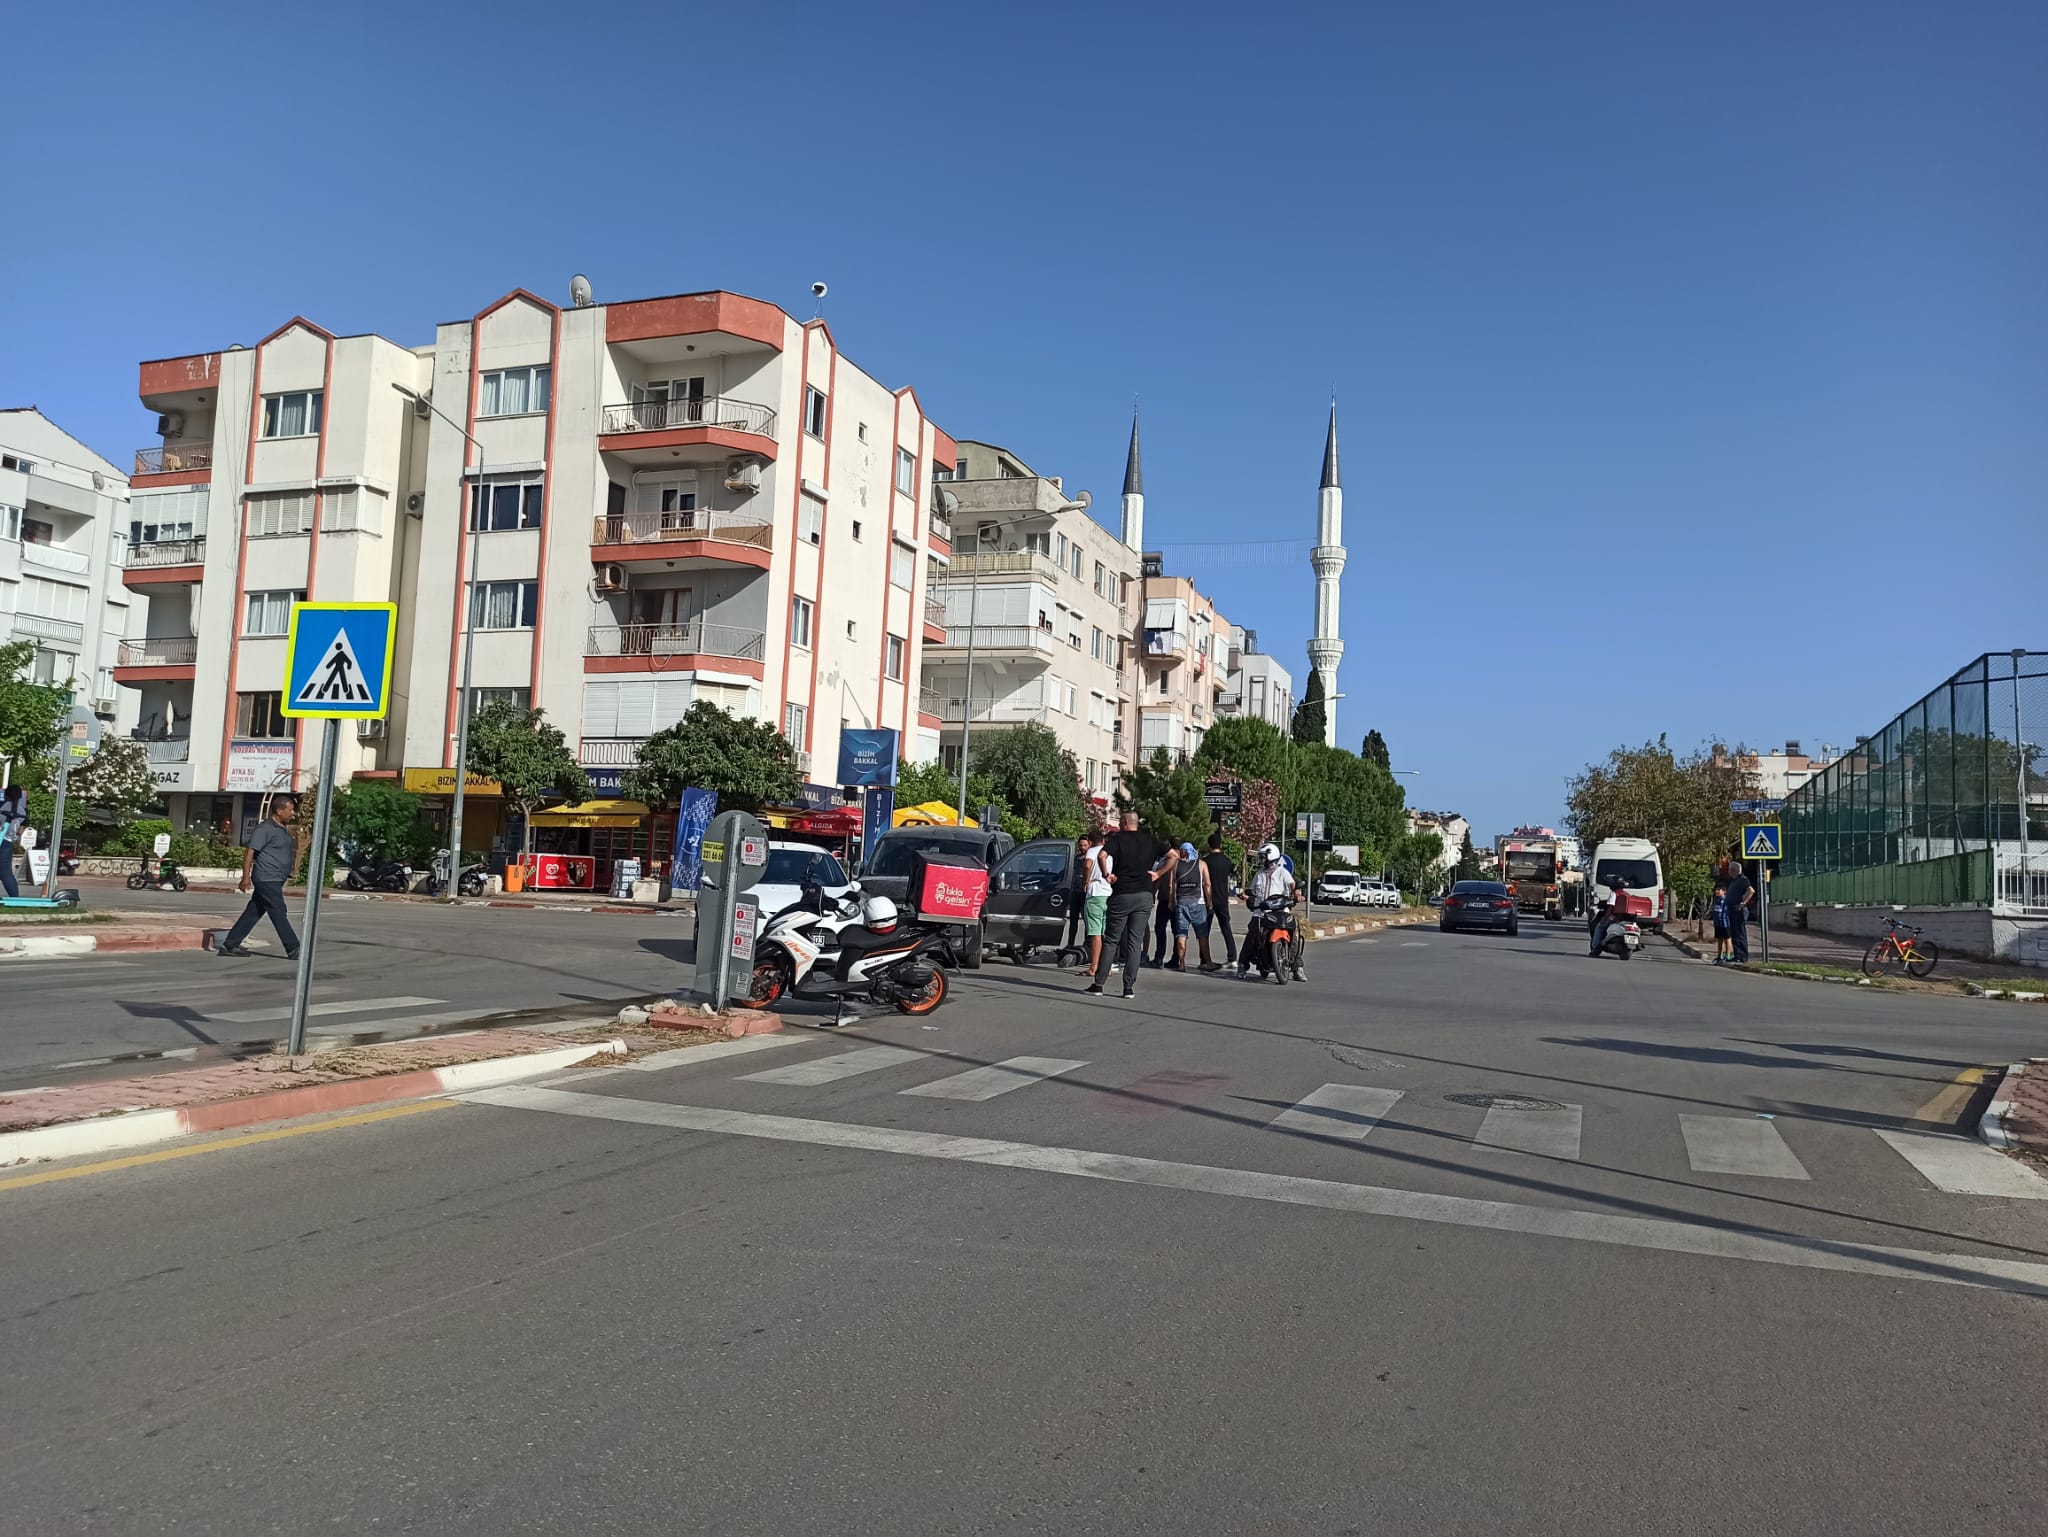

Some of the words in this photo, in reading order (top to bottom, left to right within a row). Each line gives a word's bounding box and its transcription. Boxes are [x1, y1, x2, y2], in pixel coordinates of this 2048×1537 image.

[853, 757, 879, 765] BAKKAL
[231, 767, 246, 776] AYKA
[155, 772, 180, 784] GAZ
[462, 778, 490, 787] AKKAL
